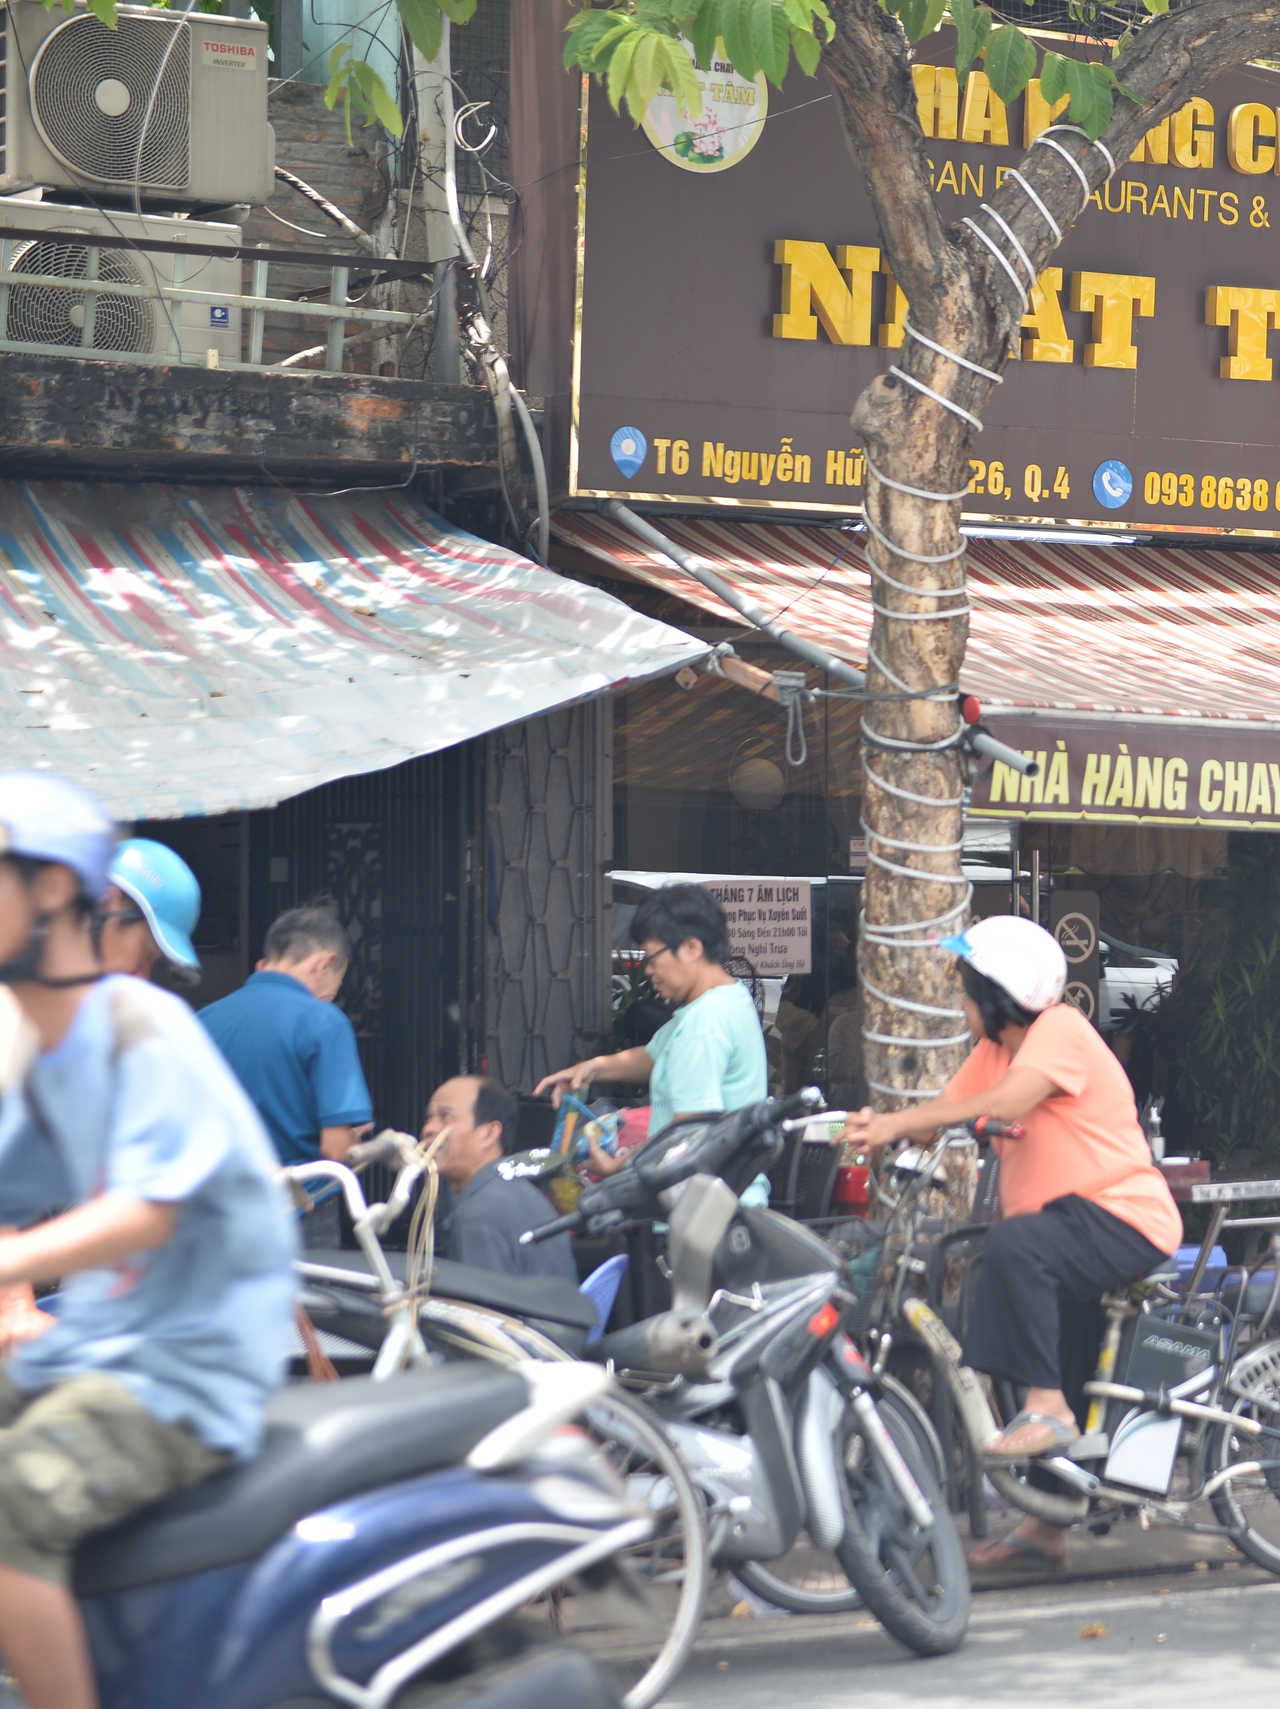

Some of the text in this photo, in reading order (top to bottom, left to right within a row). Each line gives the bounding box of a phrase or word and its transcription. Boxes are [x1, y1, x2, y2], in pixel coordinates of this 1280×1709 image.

[204, 42, 255, 57] TOSHIBA
[213, 59, 246, 69] INVERTER
[710, 81, 756, 106] TÂM
[1249, 195, 1271, 228] &
[654, 438, 690, 476] T6
[702, 437, 811, 487] Nguyễn
[825, 447, 870, 487] Hữ
[1024, 463, 1071, 503] Q.4
[1144, 471, 1195, 508] 093
[1200, 475, 1269, 512] 8638
[989, 739, 1070, 806] NHÀ
[1081, 743, 1188, 811] HÀNG
[747, 888, 754, 902] 7
[757, 884, 774, 902] ÂM
[776, 887, 800, 906] LỊCH
[738, 908, 757, 924] Phục
[758, 909, 767, 924] Vụ
[768, 908, 790, 922] Xuyên
[791, 905, 808, 921] Suốt
[737, 927, 756, 940] Sáng
[757, 925, 771, 938] Đến
[772, 926, 796, 938] 21h00
[797, 925, 808, 937] Tối
[769, 942, 788, 954] Trưa
[1142, 1334, 1212, 1361] ASAMA
